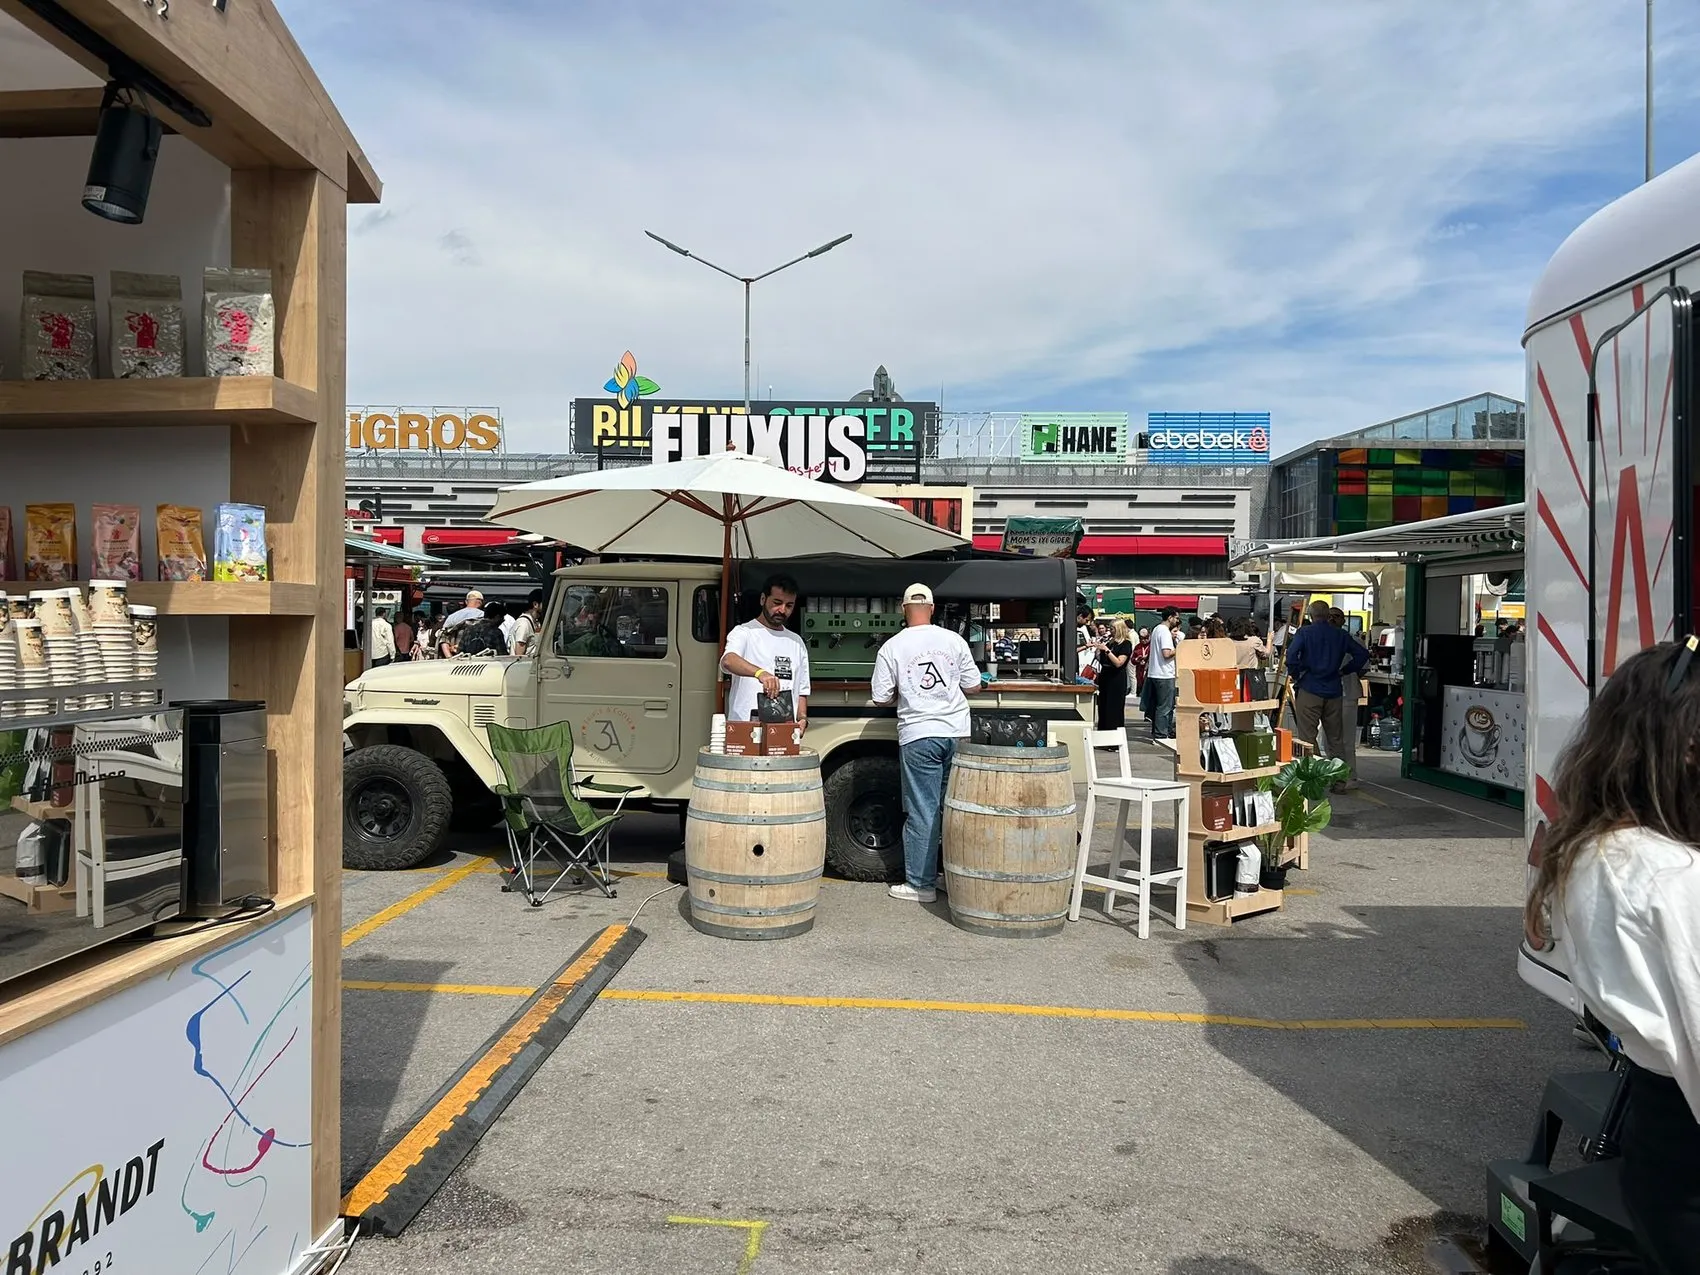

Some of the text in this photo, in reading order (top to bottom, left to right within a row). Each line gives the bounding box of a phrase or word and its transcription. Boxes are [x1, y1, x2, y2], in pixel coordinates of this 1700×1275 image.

[1062, 426, 1117, 453] HANE
[1149, 428, 1247, 449] ebebek
[0, 1137, 165, 1275] BRANDT
